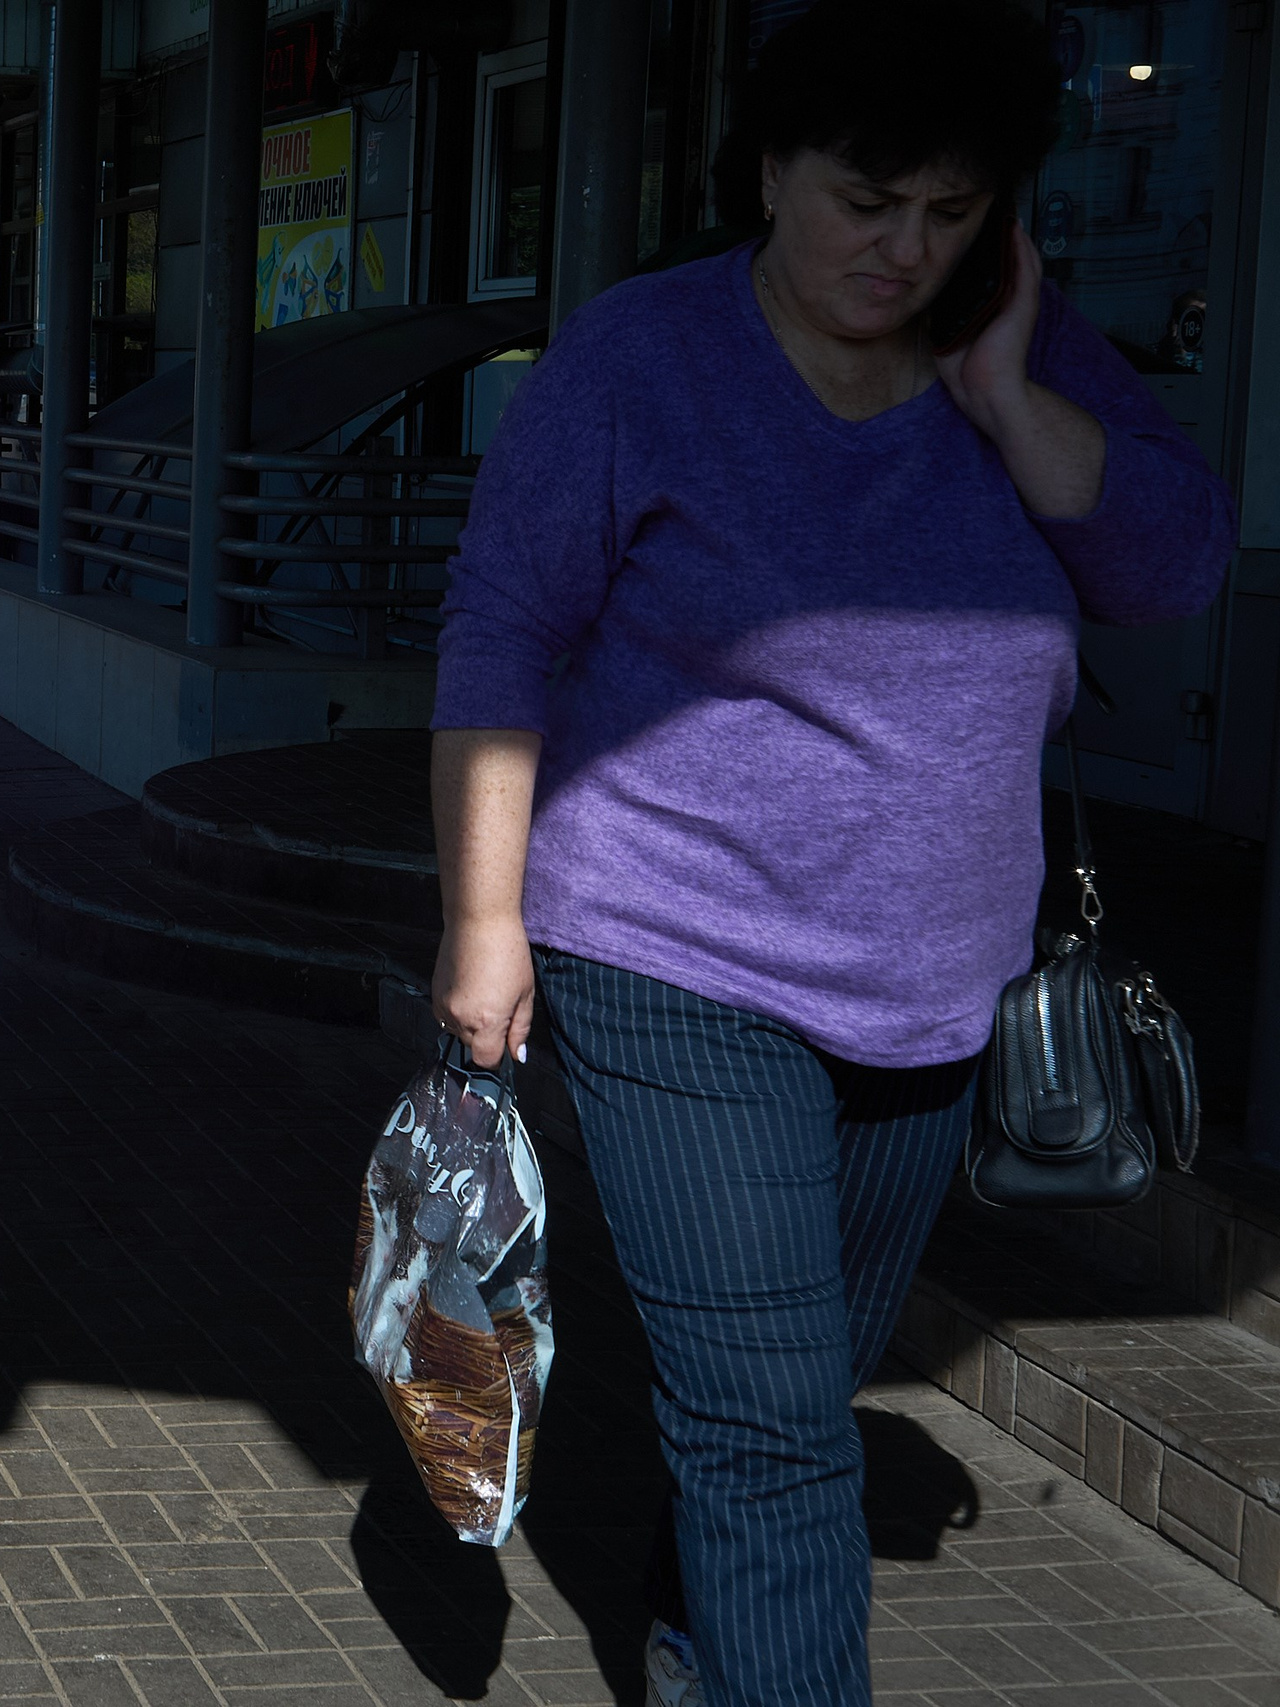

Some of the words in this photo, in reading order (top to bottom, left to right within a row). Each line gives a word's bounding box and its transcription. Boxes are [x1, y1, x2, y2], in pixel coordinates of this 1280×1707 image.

[261, 129, 311, 180] ОЧНОЕ
[293, 167, 347, 223] КЛЮЧЕЙ
[1184, 320, 1201, 337] 18+
